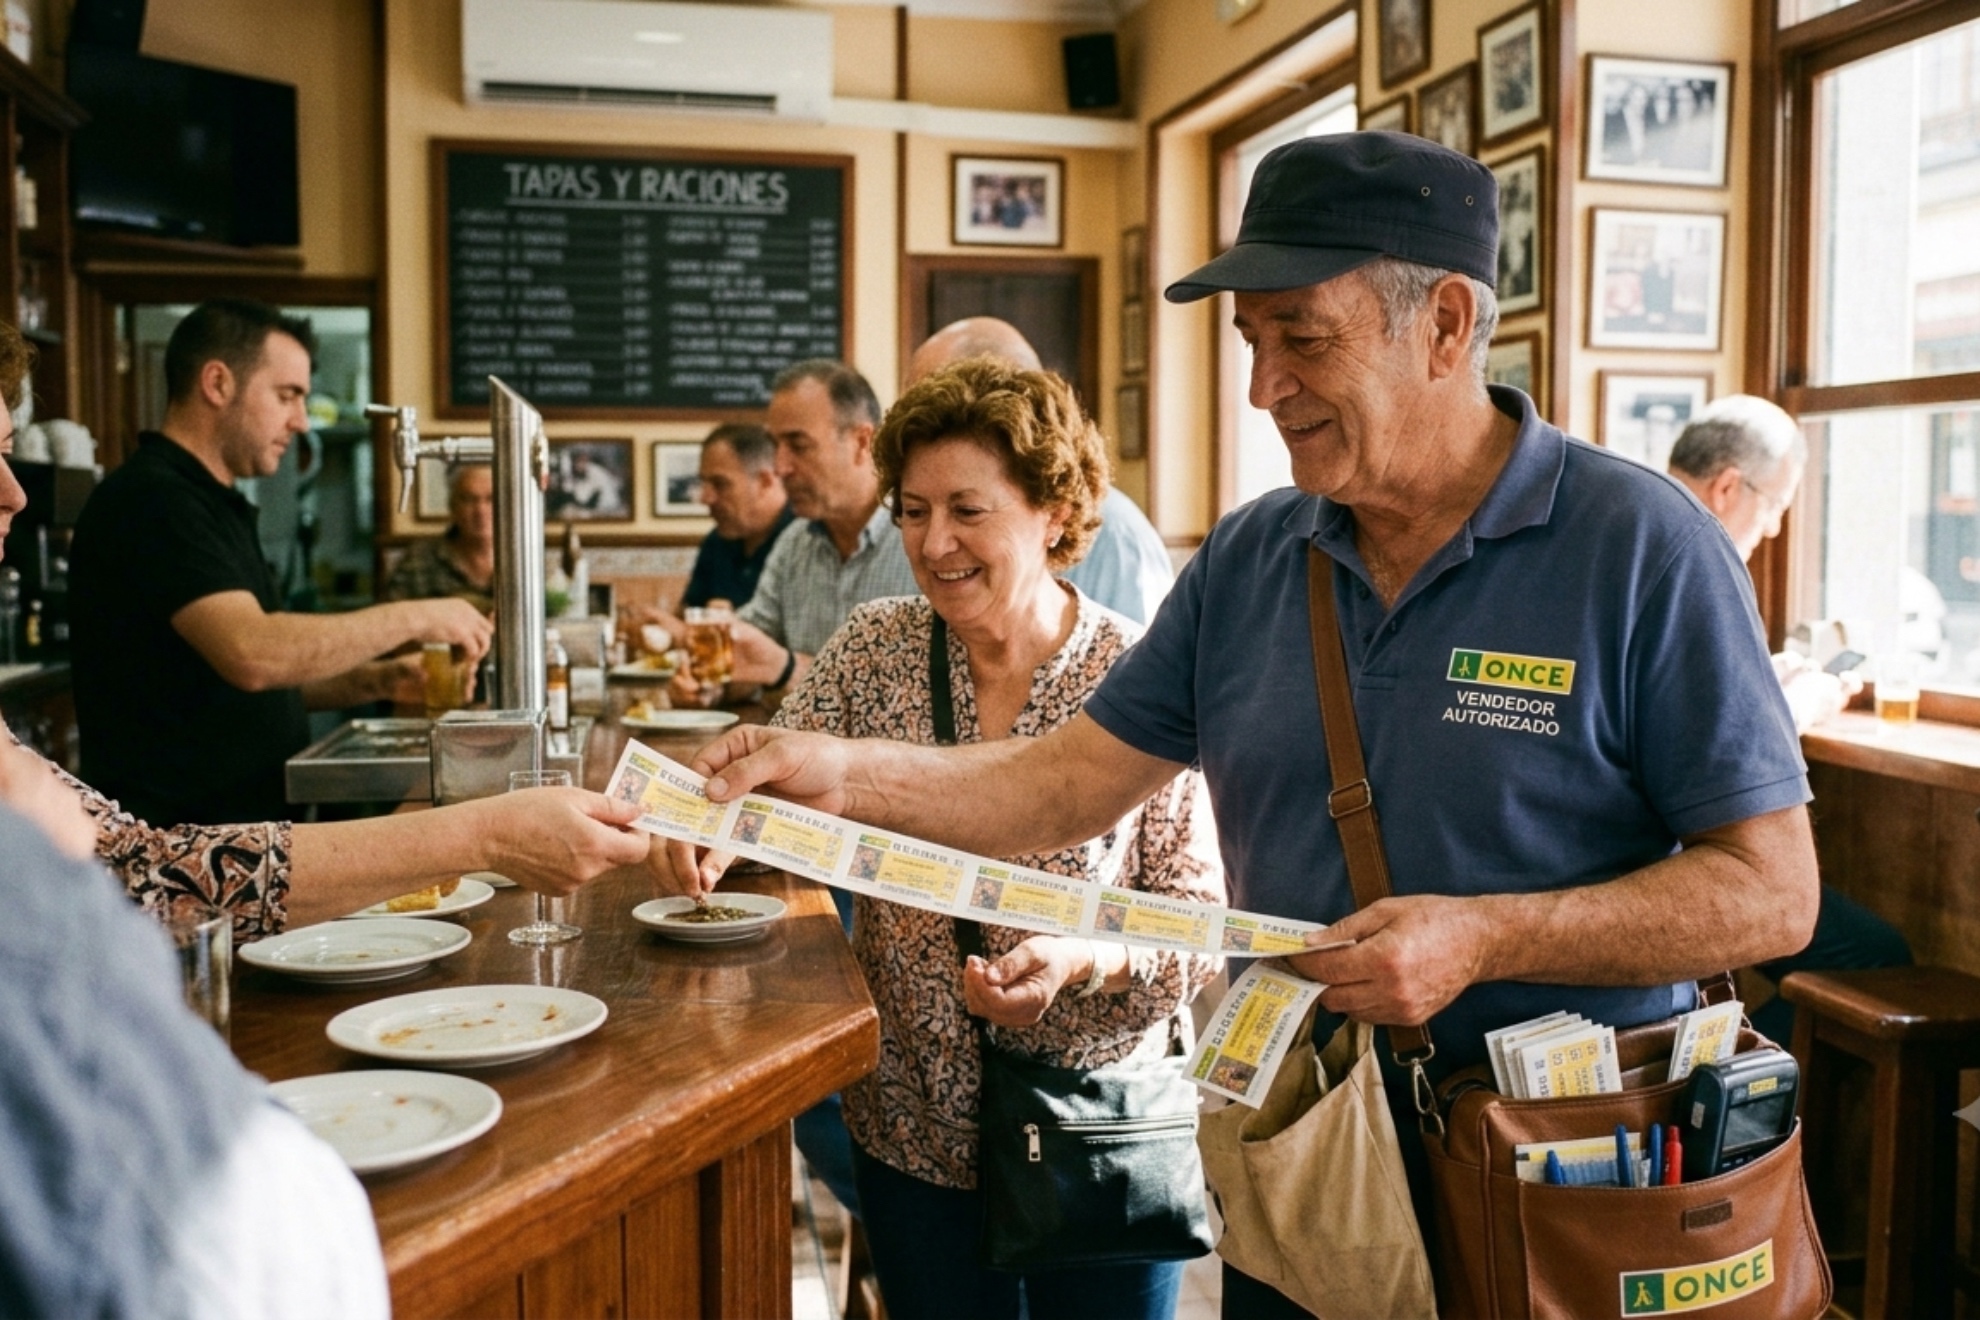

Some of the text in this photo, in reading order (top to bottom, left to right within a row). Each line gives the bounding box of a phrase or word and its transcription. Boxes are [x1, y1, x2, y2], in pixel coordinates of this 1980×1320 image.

[505, 164, 789, 206] TAPAS Y RACIONES
[1486, 661, 1565, 686] ONCE
[1456, 691, 1555, 716] VENDEDOR
[1443, 708, 1559, 735] AUTORIZADO
[1673, 1252, 1766, 1302] ONCE
